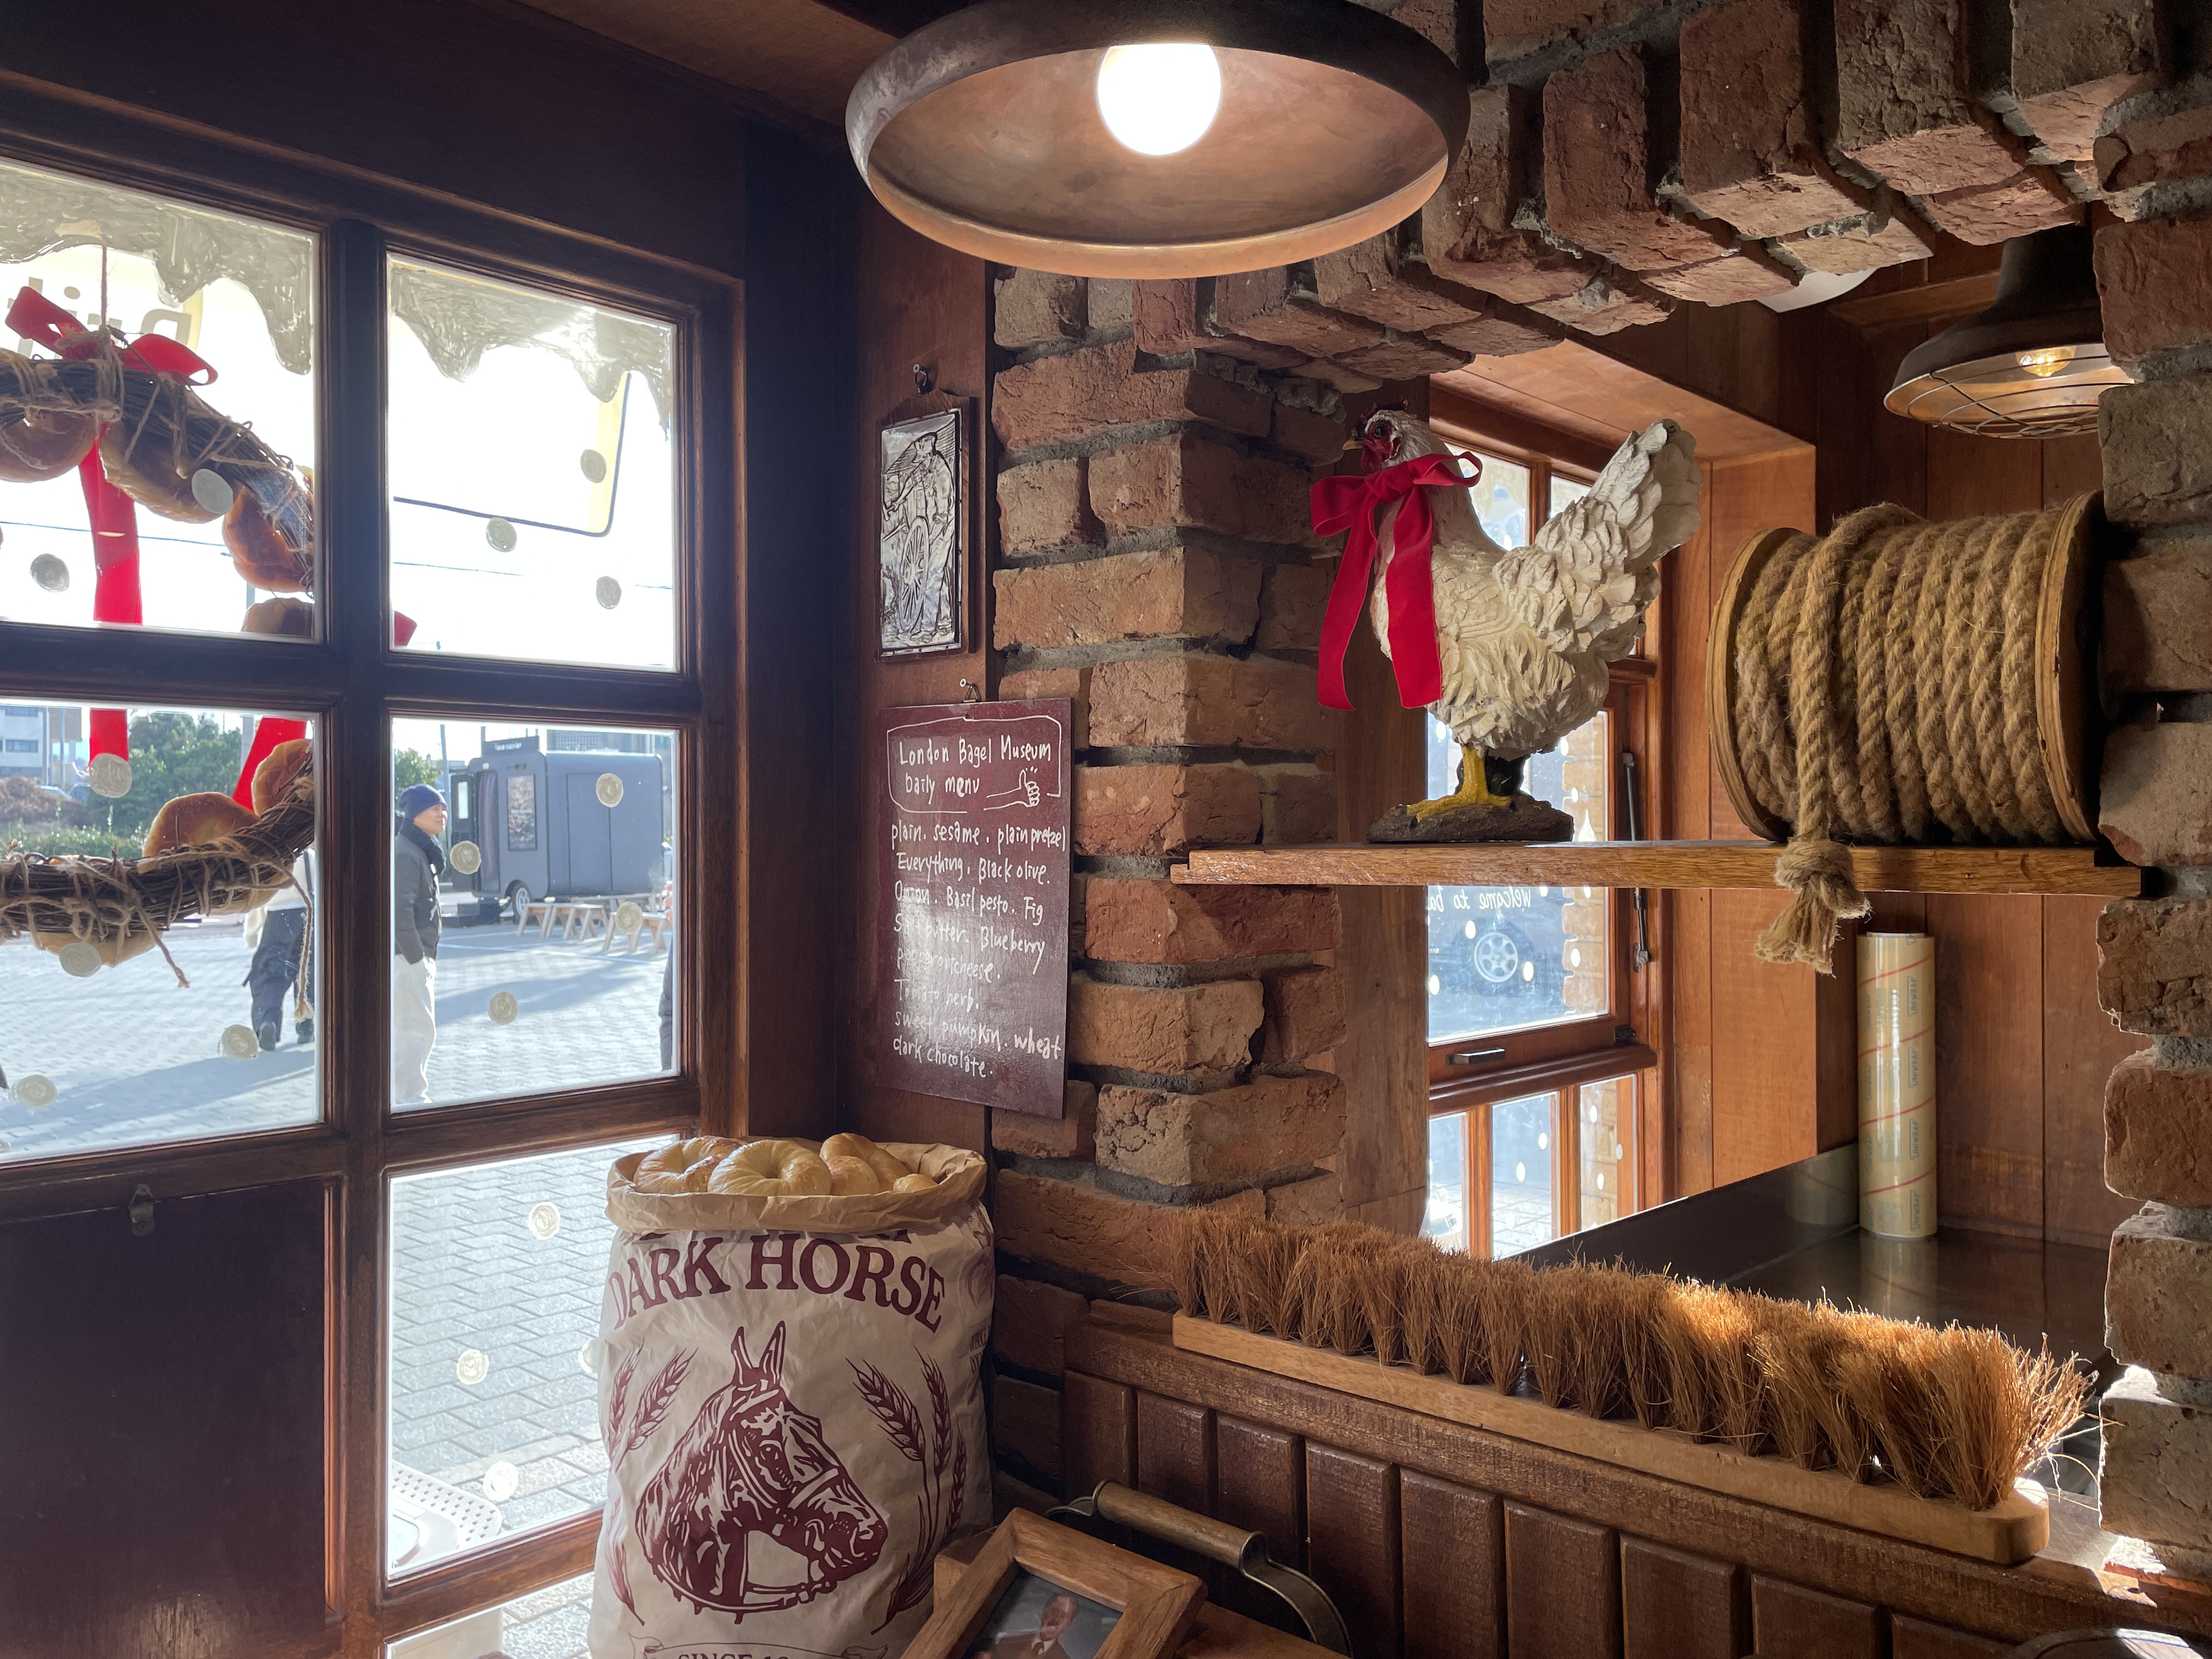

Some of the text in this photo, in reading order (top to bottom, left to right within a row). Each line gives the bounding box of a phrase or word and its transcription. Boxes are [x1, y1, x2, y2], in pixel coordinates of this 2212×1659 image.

[899, 734, 1052, 768] London Bagel Museum
[945, 776, 981, 798] menu
[997, 823, 1029, 855] plain
[1030, 826, 1066, 852] pretzel
[978, 856, 1013, 885] Black
[946, 885, 975, 912] Basil
[1023, 896, 1044, 926] Fig
[980, 926, 1046, 975] Blueberry
[1909, 977, 1918, 1015] UNIWRAP
[893, 1035, 923, 1064] dark
[1013, 1026, 1062, 1060] wheat
[1910, 1048, 1918, 1087] UNIWRAP
[1911, 1120, 1920, 1159] UNIWRAP
[1912, 1192, 1921, 1230] UNIWRAP
[607, 1233, 946, 1334] DARK HORSE
